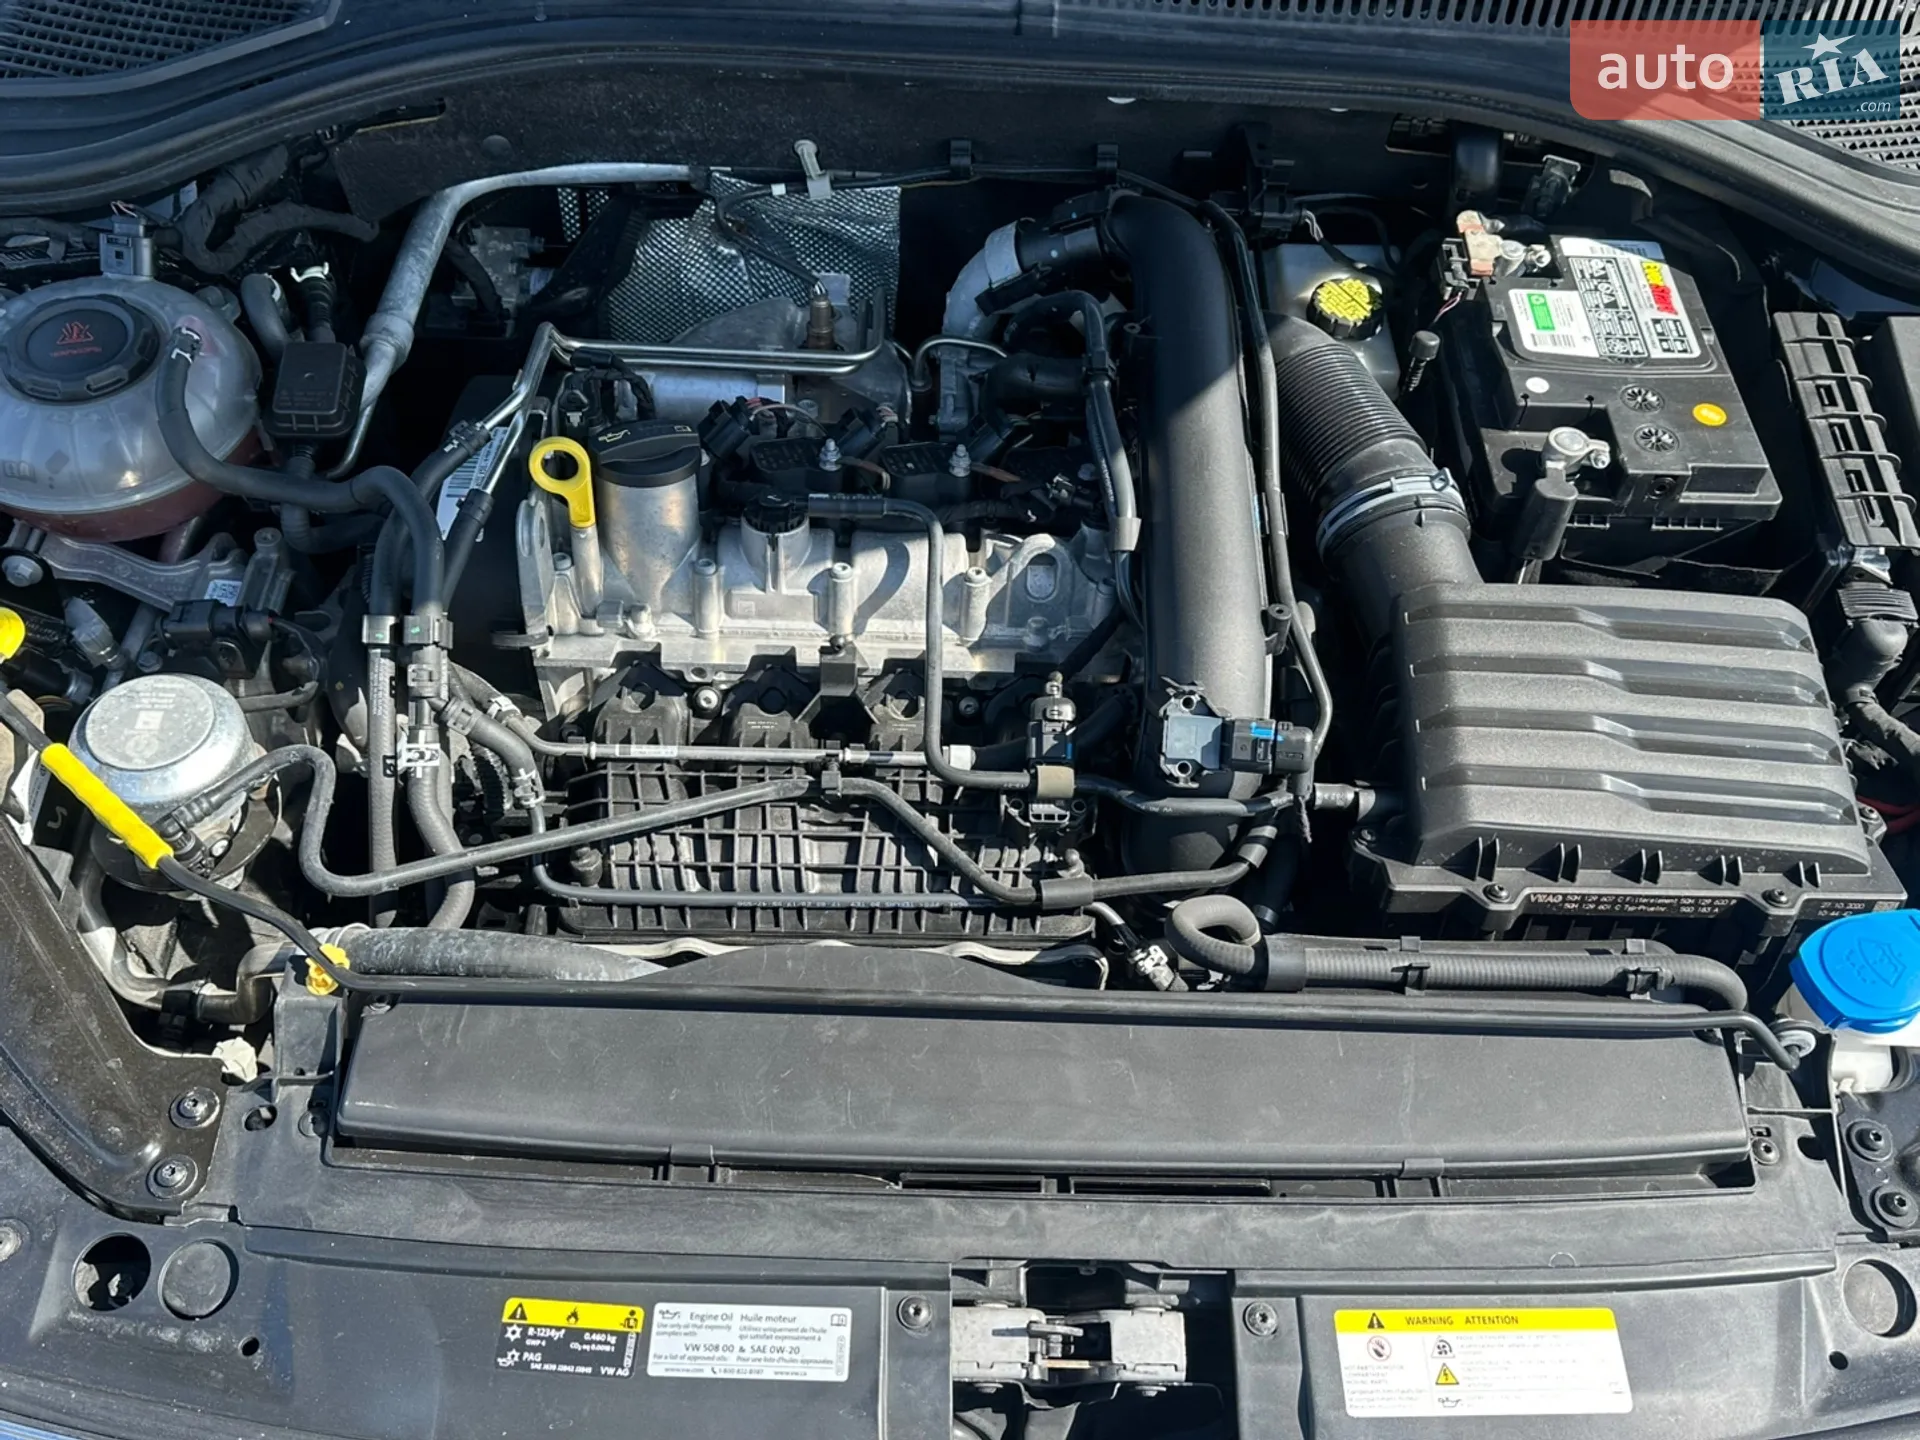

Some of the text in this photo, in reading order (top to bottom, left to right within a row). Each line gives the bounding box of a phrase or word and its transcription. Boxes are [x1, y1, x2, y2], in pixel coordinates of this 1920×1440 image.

[690, 1312, 733, 1323] Engine Oil
[740, 1313, 797, 1323] Huile moteur
[1404, 1315, 1519, 1326] WARNING ATTENTION
[527, 1327, 566, 1340] R-1234yf
[607, 1333, 618, 1344] kg
[684, 1342, 801, 1355] VW 508 00 & SAE 0W-20
[522, 1352, 542, 1362] PAG
[600, 1366, 630, 1377] VW AG
